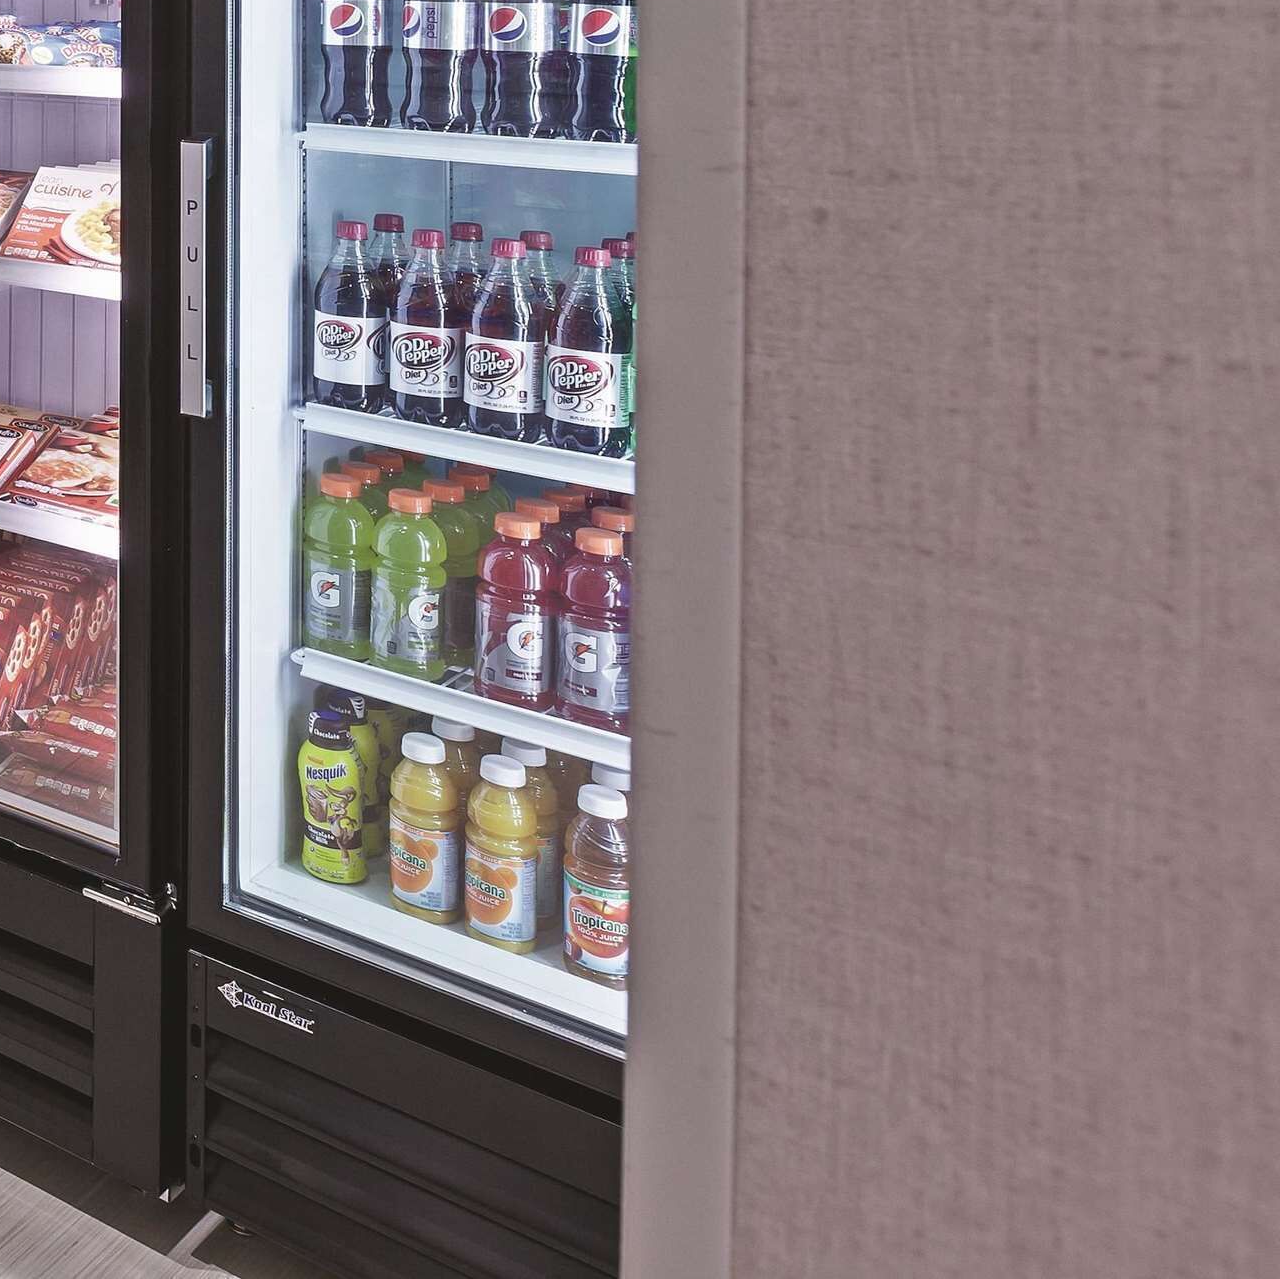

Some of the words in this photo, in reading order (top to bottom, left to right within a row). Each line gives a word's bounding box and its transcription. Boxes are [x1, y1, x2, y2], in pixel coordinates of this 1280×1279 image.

[425, 6, 438, 39] pepsi
[33, 183, 94, 199] cuisine
[187, 199, 199, 361] PULL
[319, 327, 355, 345] Pepper
[329, 326, 345, 337] Dr
[324, 347, 338, 357] Diet
[400, 340, 444, 365] Pepper
[411, 337, 432, 350] Dr
[480, 348, 500, 362] Dr
[469, 352, 514, 377] Pepper
[566, 361, 589, 375] Dr
[404, 370, 423, 380] Diet
[554, 364, 603, 389] Pepper
[472, 381, 489, 392] Diet
[556, 395, 575, 406] Diet
[312, 571, 340, 609] G
[407, 593, 439, 631] G
[506, 621, 544, 661] G
[564, 631, 599, 673] G
[313, 728, 341, 741] Chocolate
[306, 764, 348, 783] Nesquik
[307, 824, 335, 841] Chocolate
[400, 864, 421, 875] JUICE
[478, 895, 500, 906] JUICE
[572, 907, 630, 936] Tropicana
[577, 925, 598, 939] 100%
[598, 932, 624, 943] JUICE
[243, 992, 276, 1015] Kool
[279, 1006, 312, 1031] Star
